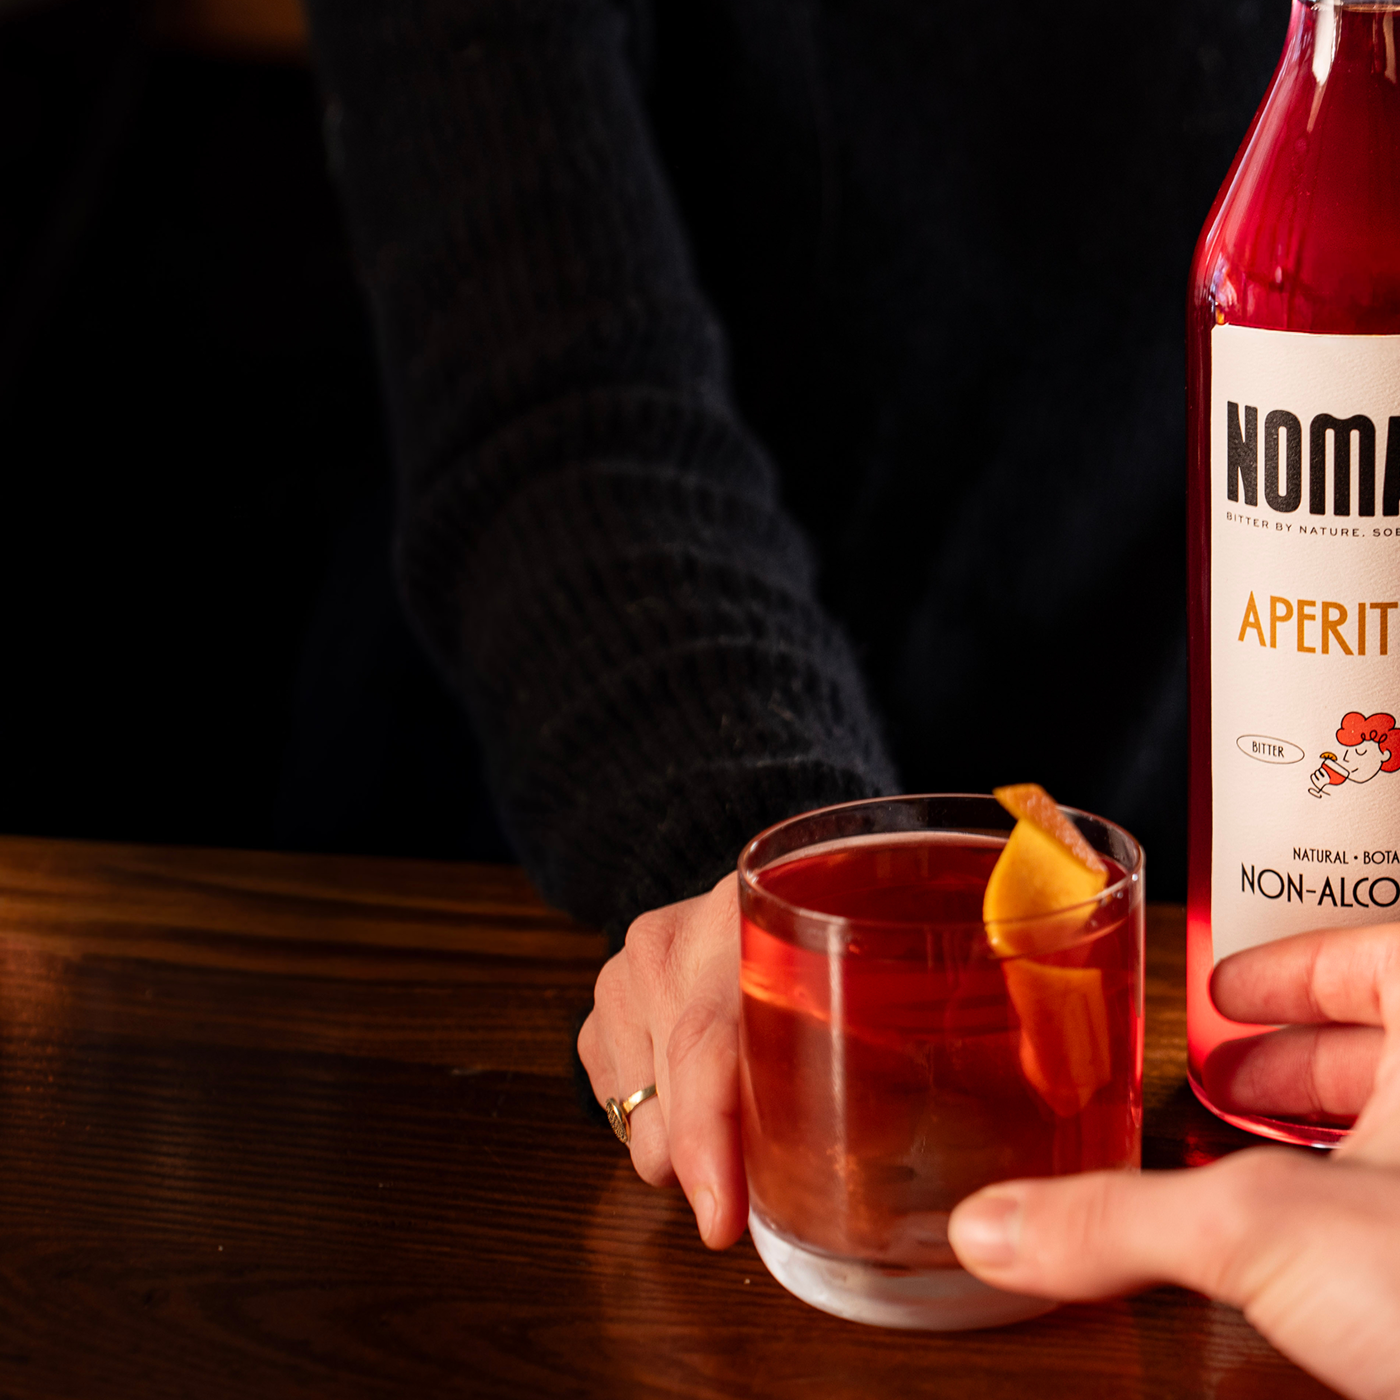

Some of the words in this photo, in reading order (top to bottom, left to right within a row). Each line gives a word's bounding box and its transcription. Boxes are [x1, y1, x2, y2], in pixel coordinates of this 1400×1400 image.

[1226, 511, 1269, 530] BITTER
[1275, 523, 1292, 533] BY
[1299, 525, 1365, 537] NATURE.
[1252, 741, 1285, 758] BITTER
[1293, 847, 1349, 864] NATURAL
